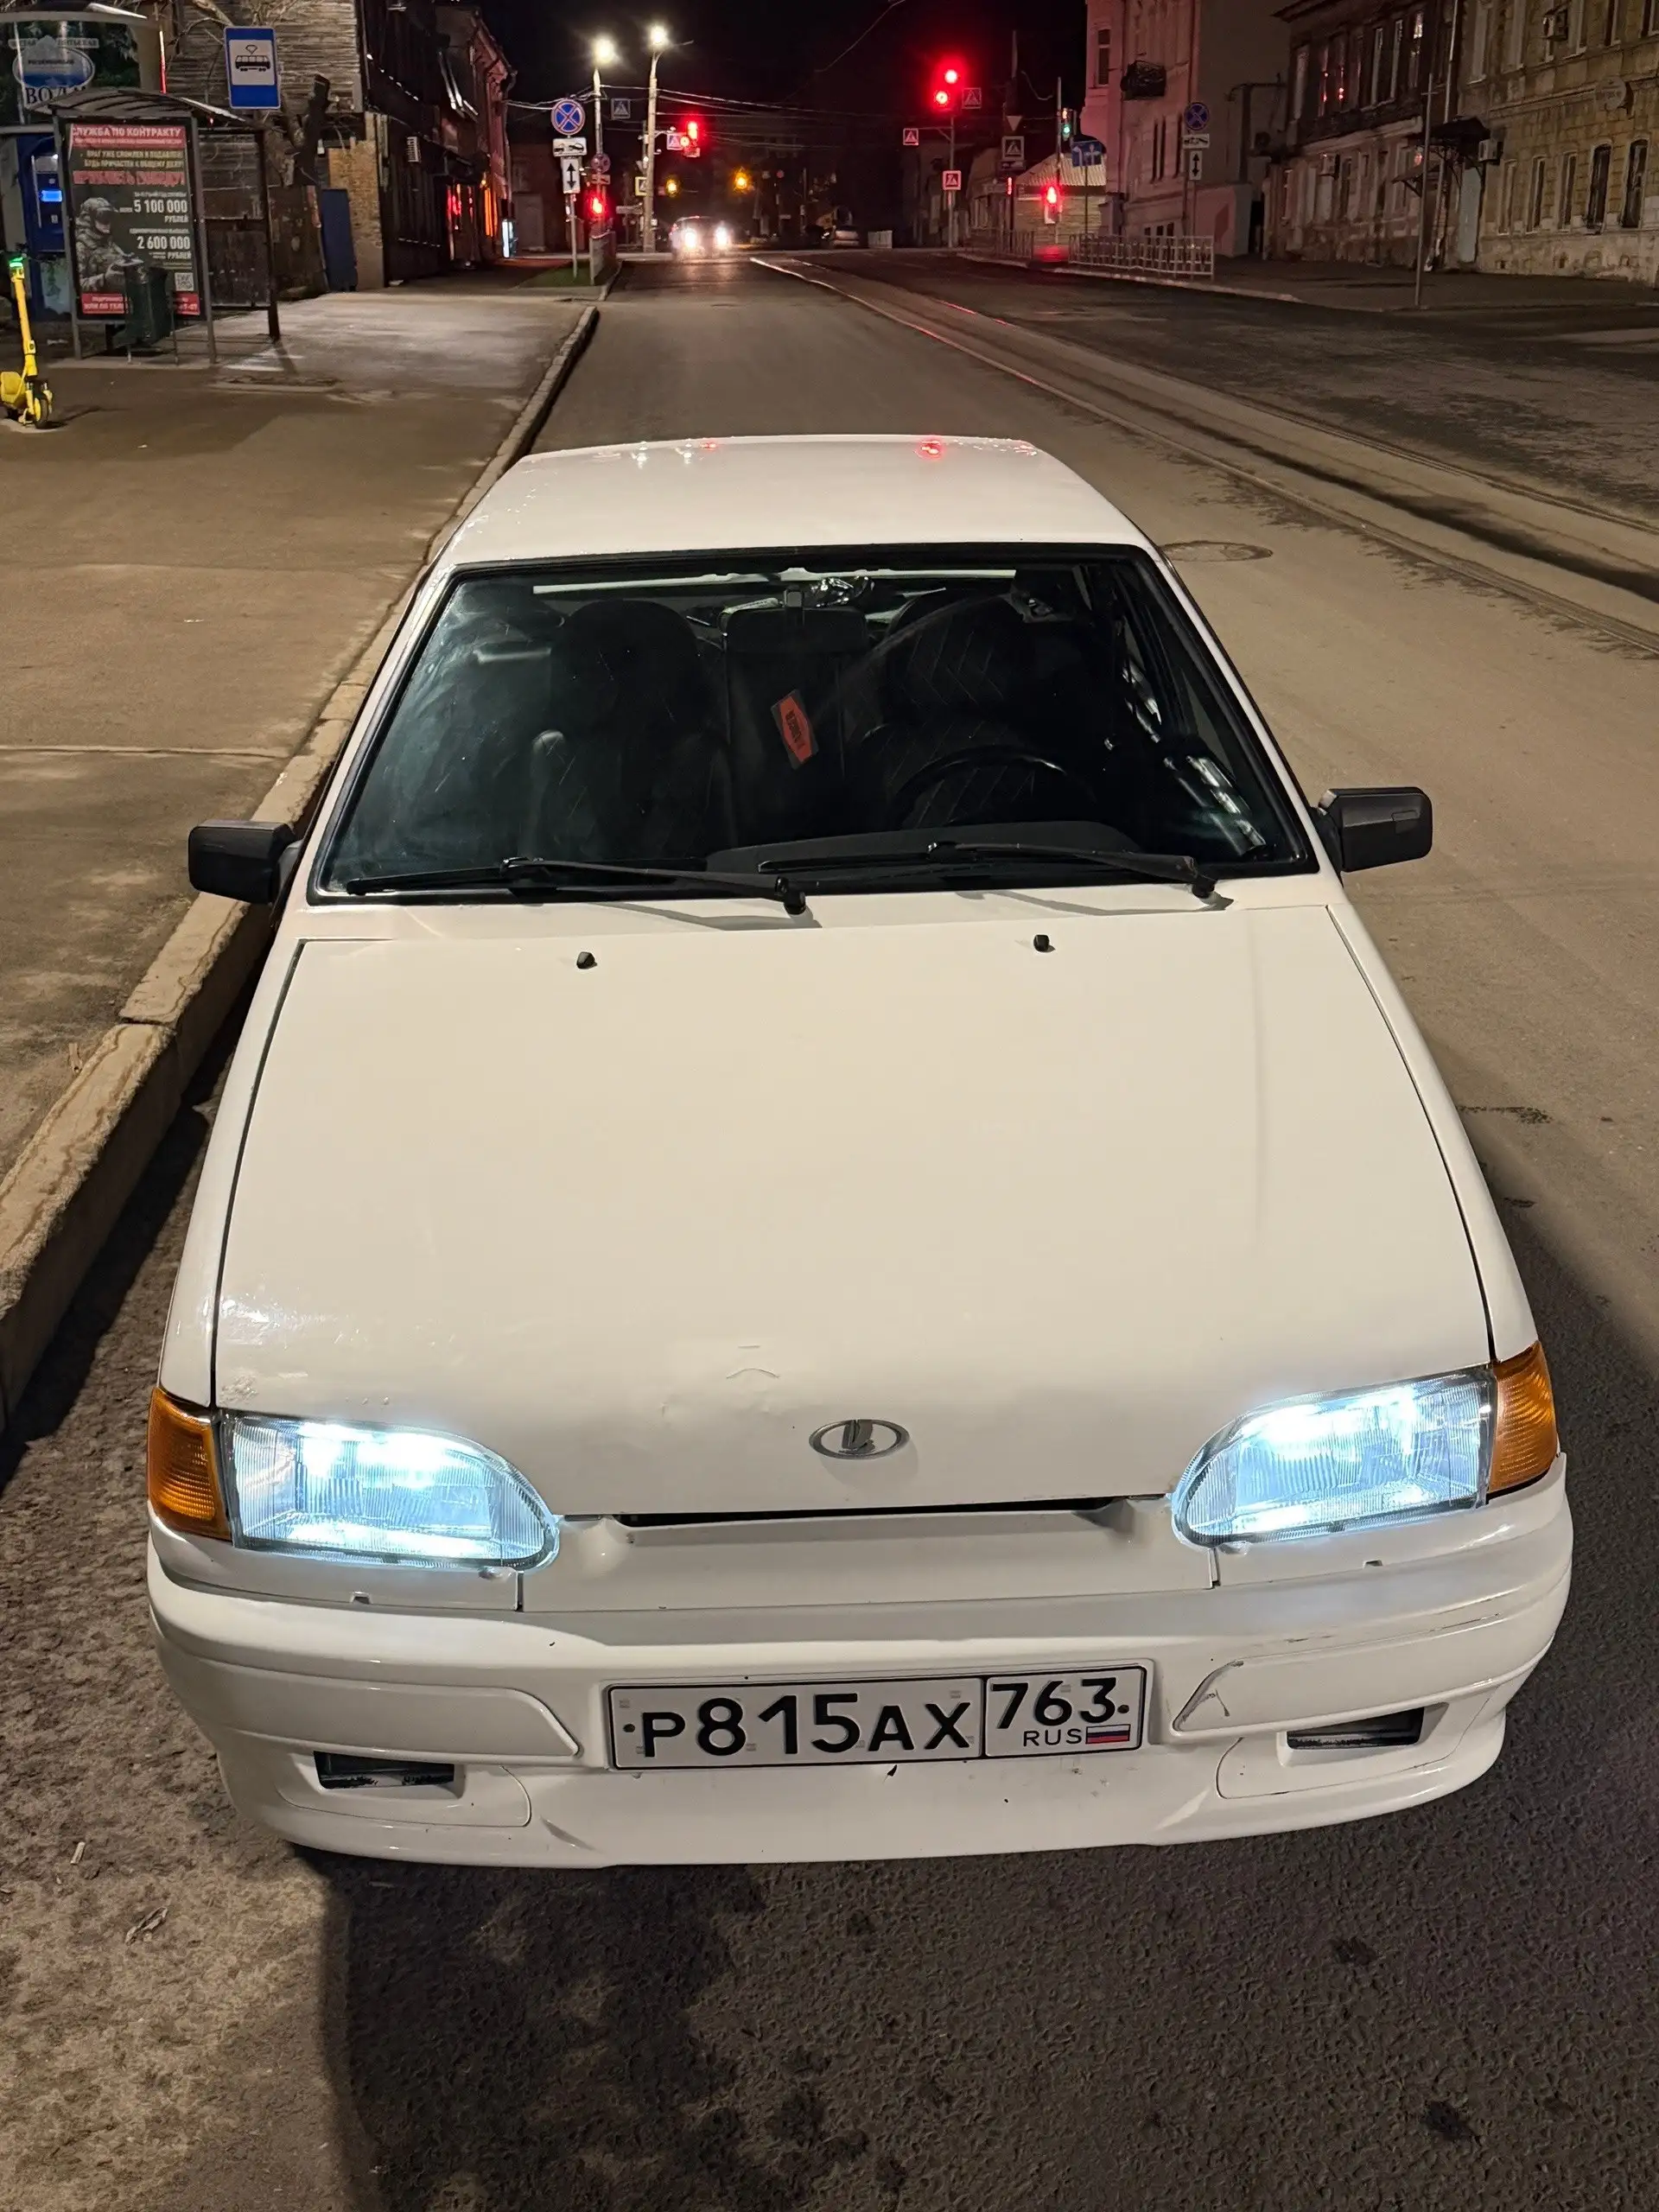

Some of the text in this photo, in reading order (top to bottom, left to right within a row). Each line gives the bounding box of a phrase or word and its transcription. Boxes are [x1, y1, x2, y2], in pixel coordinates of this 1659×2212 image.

[73, 127, 181, 137] СЛУЖБА ПО КОНТРАКТУ
[134, 200, 188, 213] 5 100 000
[137, 236, 190, 249] 2 600 000
[991, 1677, 1116, 1729] 763
[1023, 1728, 1083, 1747] RUS
